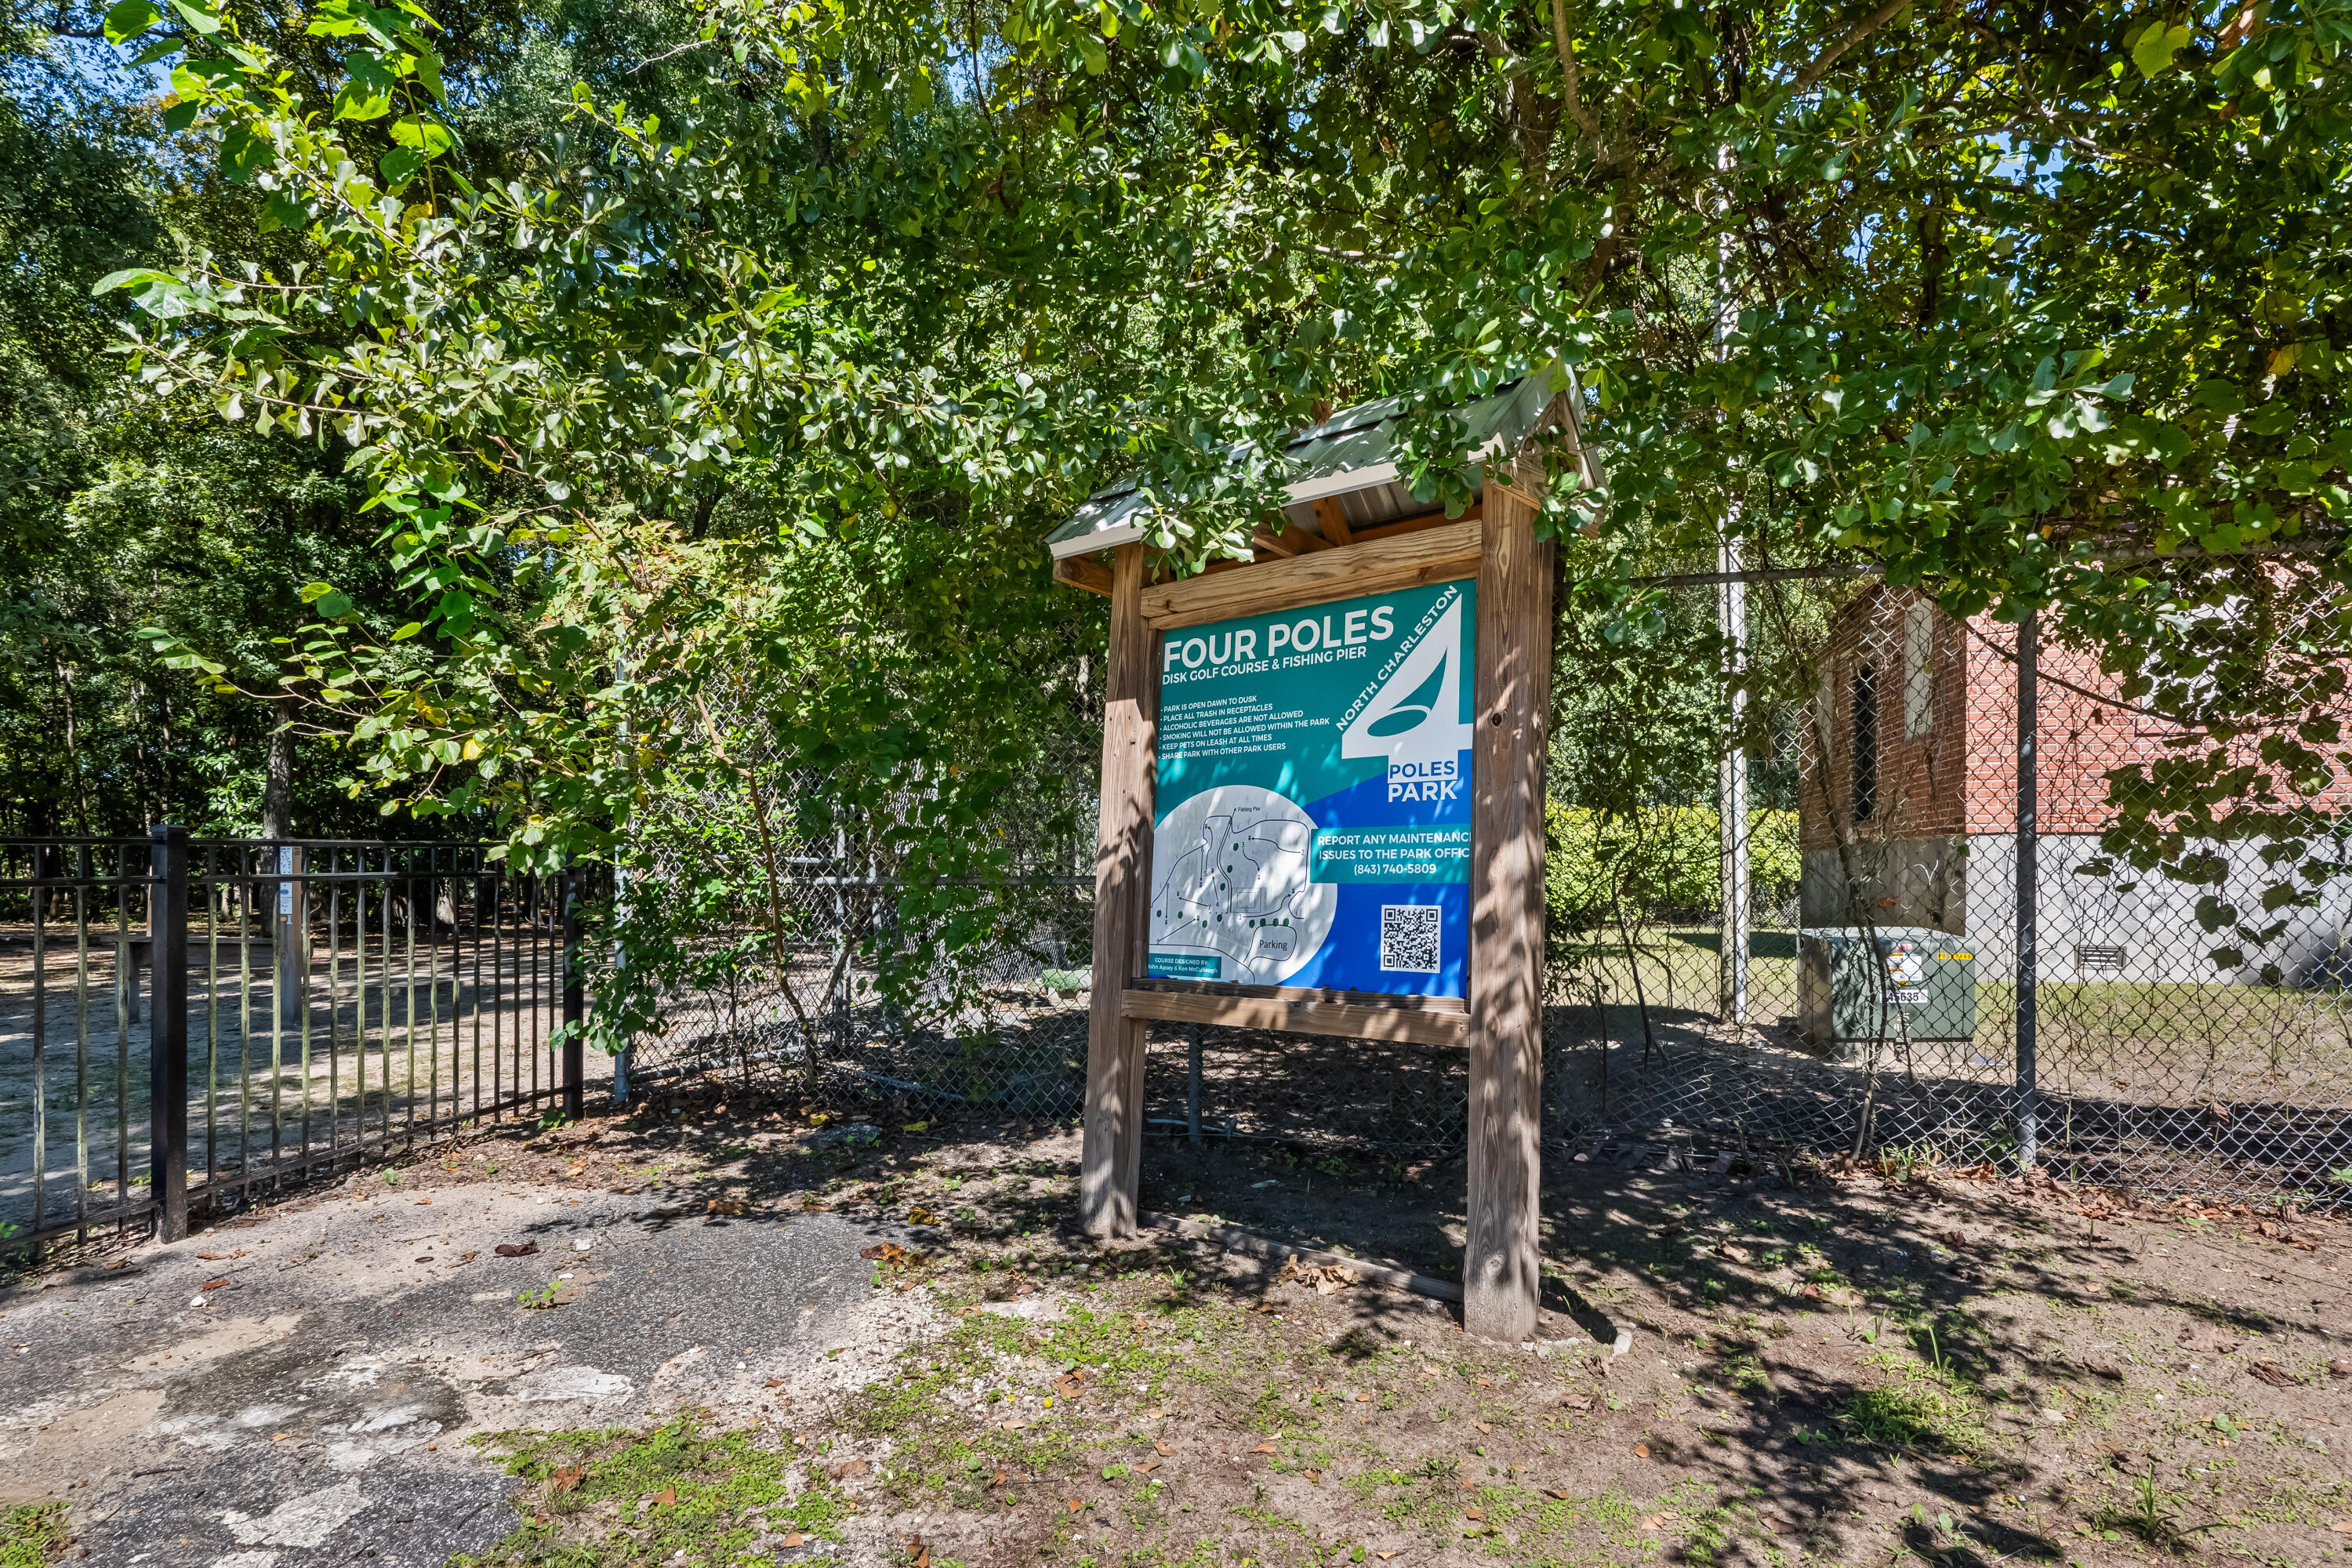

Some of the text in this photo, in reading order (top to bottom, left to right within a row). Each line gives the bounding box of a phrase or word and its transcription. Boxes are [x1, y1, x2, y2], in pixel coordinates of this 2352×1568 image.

[1163, 605, 1394, 672] FOUR POLES
[1162, 646, 1366, 685] DISK GOLF COURSE & FISHING PIER
[1336, 585, 1457, 731] NORTH CHARLESTON
[1207, 699, 1227, 707] DAWN
[1239, 695, 1257, 704] DUSK
[1227, 703, 1272, 715] RECEPTACLES
[1163, 722, 1197, 731] ALCOHOLIC
[1199, 717, 1236, 728] BEVERAGES
[1238, 715, 1252, 724] ARE
[1269, 710, 1304, 720] ALLOWED
[1163, 732, 1191, 741] SMOKING
[1233, 724, 1266, 734] ALLOWED
[1268, 721, 1293, 730] WITHIN
[1294, 720, 1308, 728] THE
[1310, 717, 1330, 727] PARK
[1184, 750, 1200, 758] PARK
[1220, 746, 1242, 755] OTHER
[1243, 744, 1261, 753] PARK
[1263, 742, 1286, 752] USERS
[1389, 760, 1455, 779] POLES
[1388, 780, 1458, 803] PARK
[1317, 832, 1471, 846] REPORT ANY MAINTENANC
[1319, 848, 1470, 860] ISSUES TO THE PARK OFFIC
[1354, 863, 1436, 876] (843) 740-5809
[1259, 939, 1287, 951] Parking
